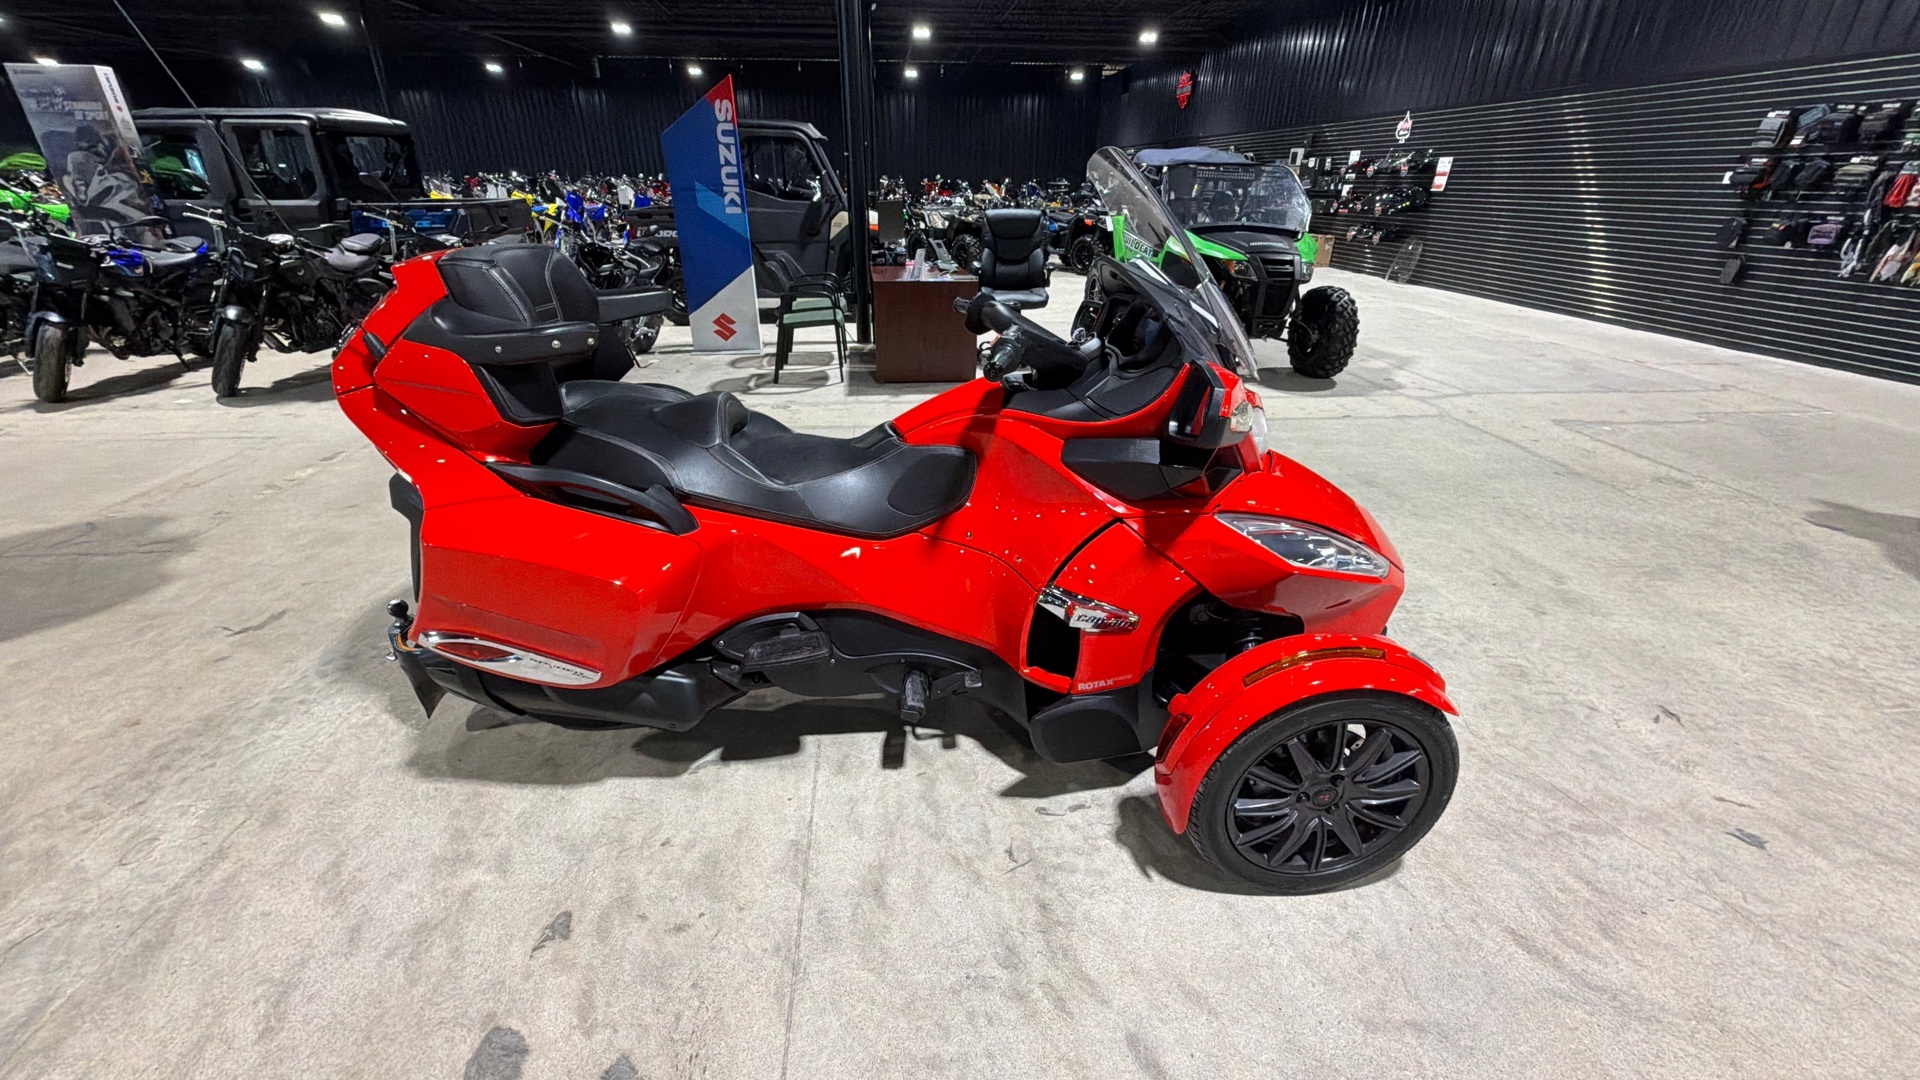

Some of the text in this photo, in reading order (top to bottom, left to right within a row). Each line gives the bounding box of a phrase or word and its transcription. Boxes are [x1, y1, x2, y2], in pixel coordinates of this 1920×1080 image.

[714, 98, 742, 214] SUZUKI
[1124, 234, 1153, 256] WILDCAT
[1078, 679, 1114, 691] ROTAX
